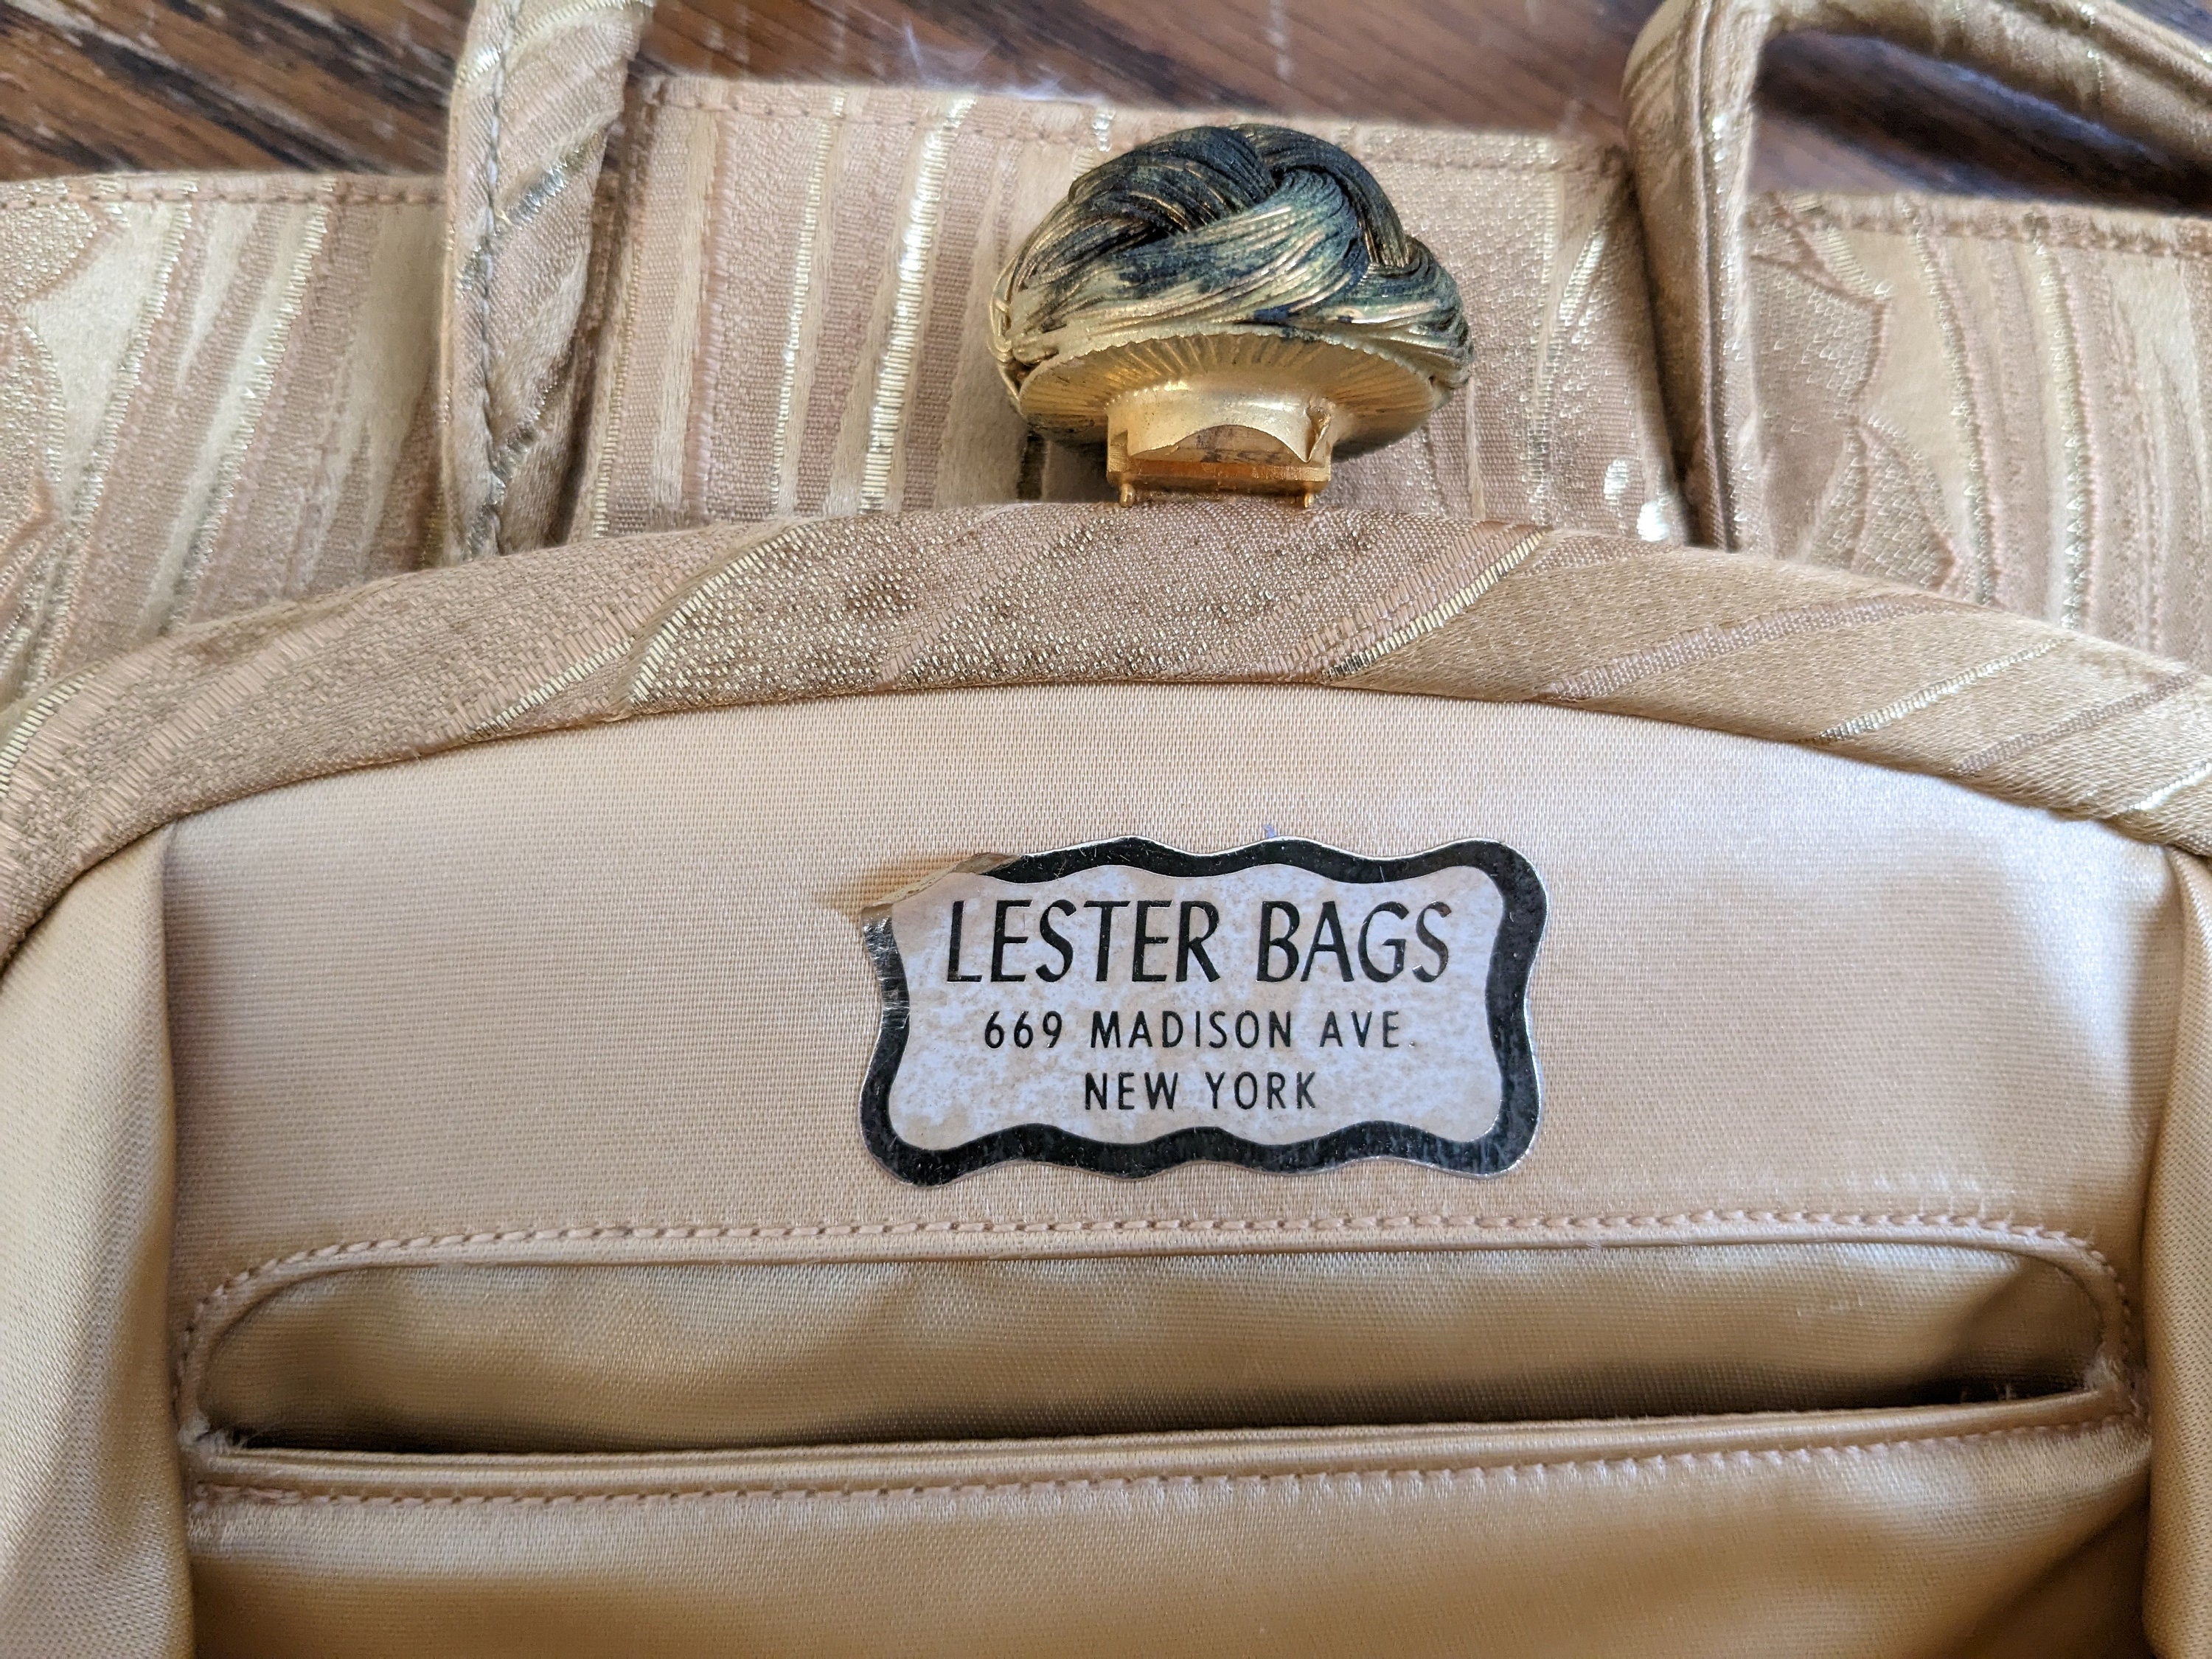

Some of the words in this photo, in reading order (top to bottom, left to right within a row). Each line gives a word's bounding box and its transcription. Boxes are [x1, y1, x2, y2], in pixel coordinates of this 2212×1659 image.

[947, 899, 1221, 983] LESTER
[1256, 900, 1452, 983] BAGS
[984, 1010, 1062, 1049] 669
[1090, 1009, 1291, 1049] MADISON
[1319, 1010, 1416, 1049] AVE.
[1085, 1071, 1179, 1111] NEW
[1204, 1071, 1317, 1110] YORK
